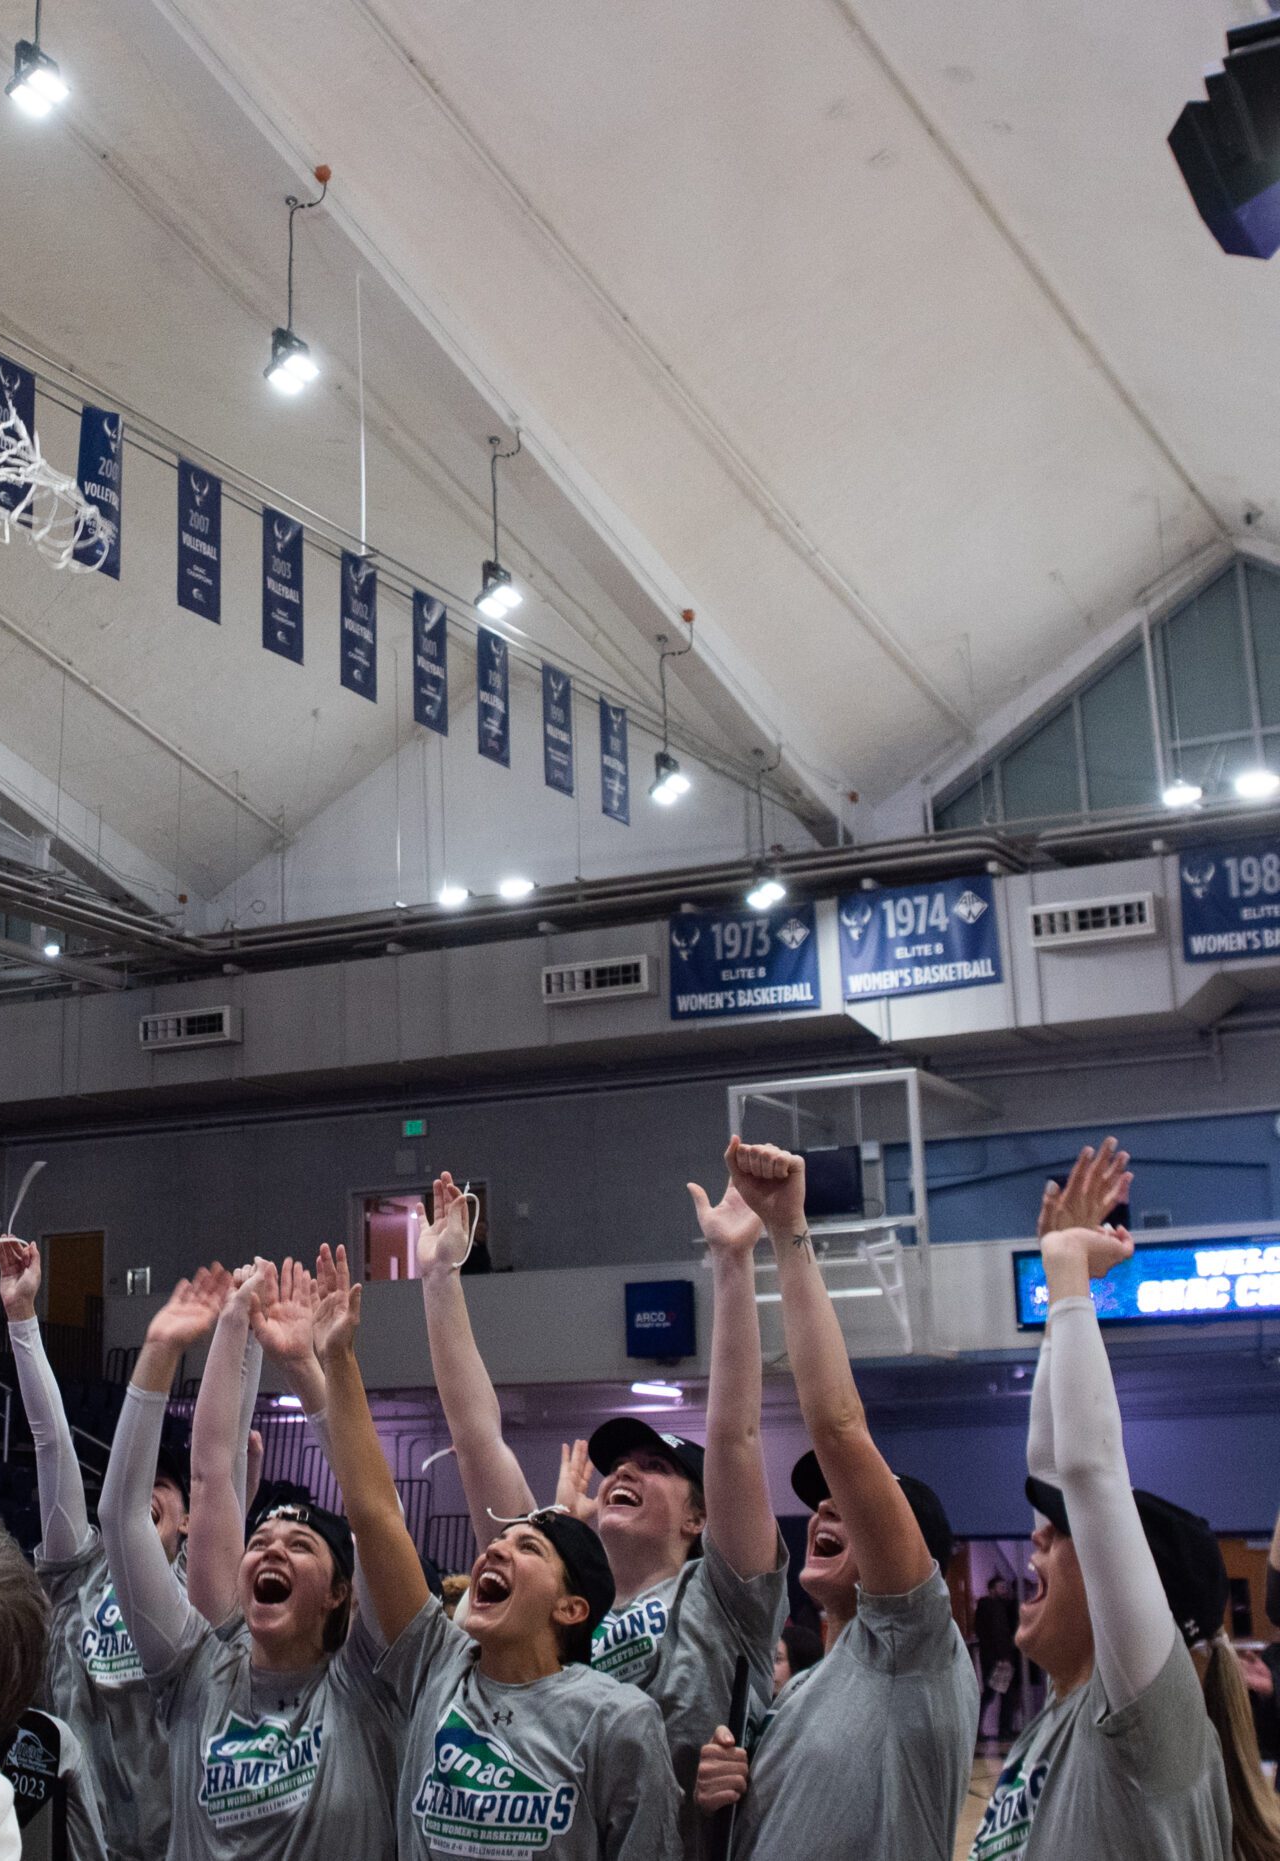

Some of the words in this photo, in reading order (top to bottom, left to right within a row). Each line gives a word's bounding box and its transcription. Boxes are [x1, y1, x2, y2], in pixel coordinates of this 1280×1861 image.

[182, 531, 218, 560] VOLLEYBALL
[266, 576, 300, 604] VOLLEYBALL
[882, 893, 949, 938] 1974
[710, 920, 770, 960] 1973
[895, 944, 933, 959] ELITE
[934, 942, 944, 955] 8
[1191, 930, 1261, 954] WOMEN'S
[721, 967, 755, 981] ELITE
[757, 966, 767, 978] 8
[848, 969, 912, 993] WOMEN'S
[913, 958, 995, 986] BASKETBALL
[676, 991, 735, 1012] WOMEN'S
[736, 982, 814, 1007] BASKETBALL
[438, 1743, 515, 1788] gnac
[11, 1772, 46, 1800] 2023
[480, 1828, 544, 1842] BASKETBALL
